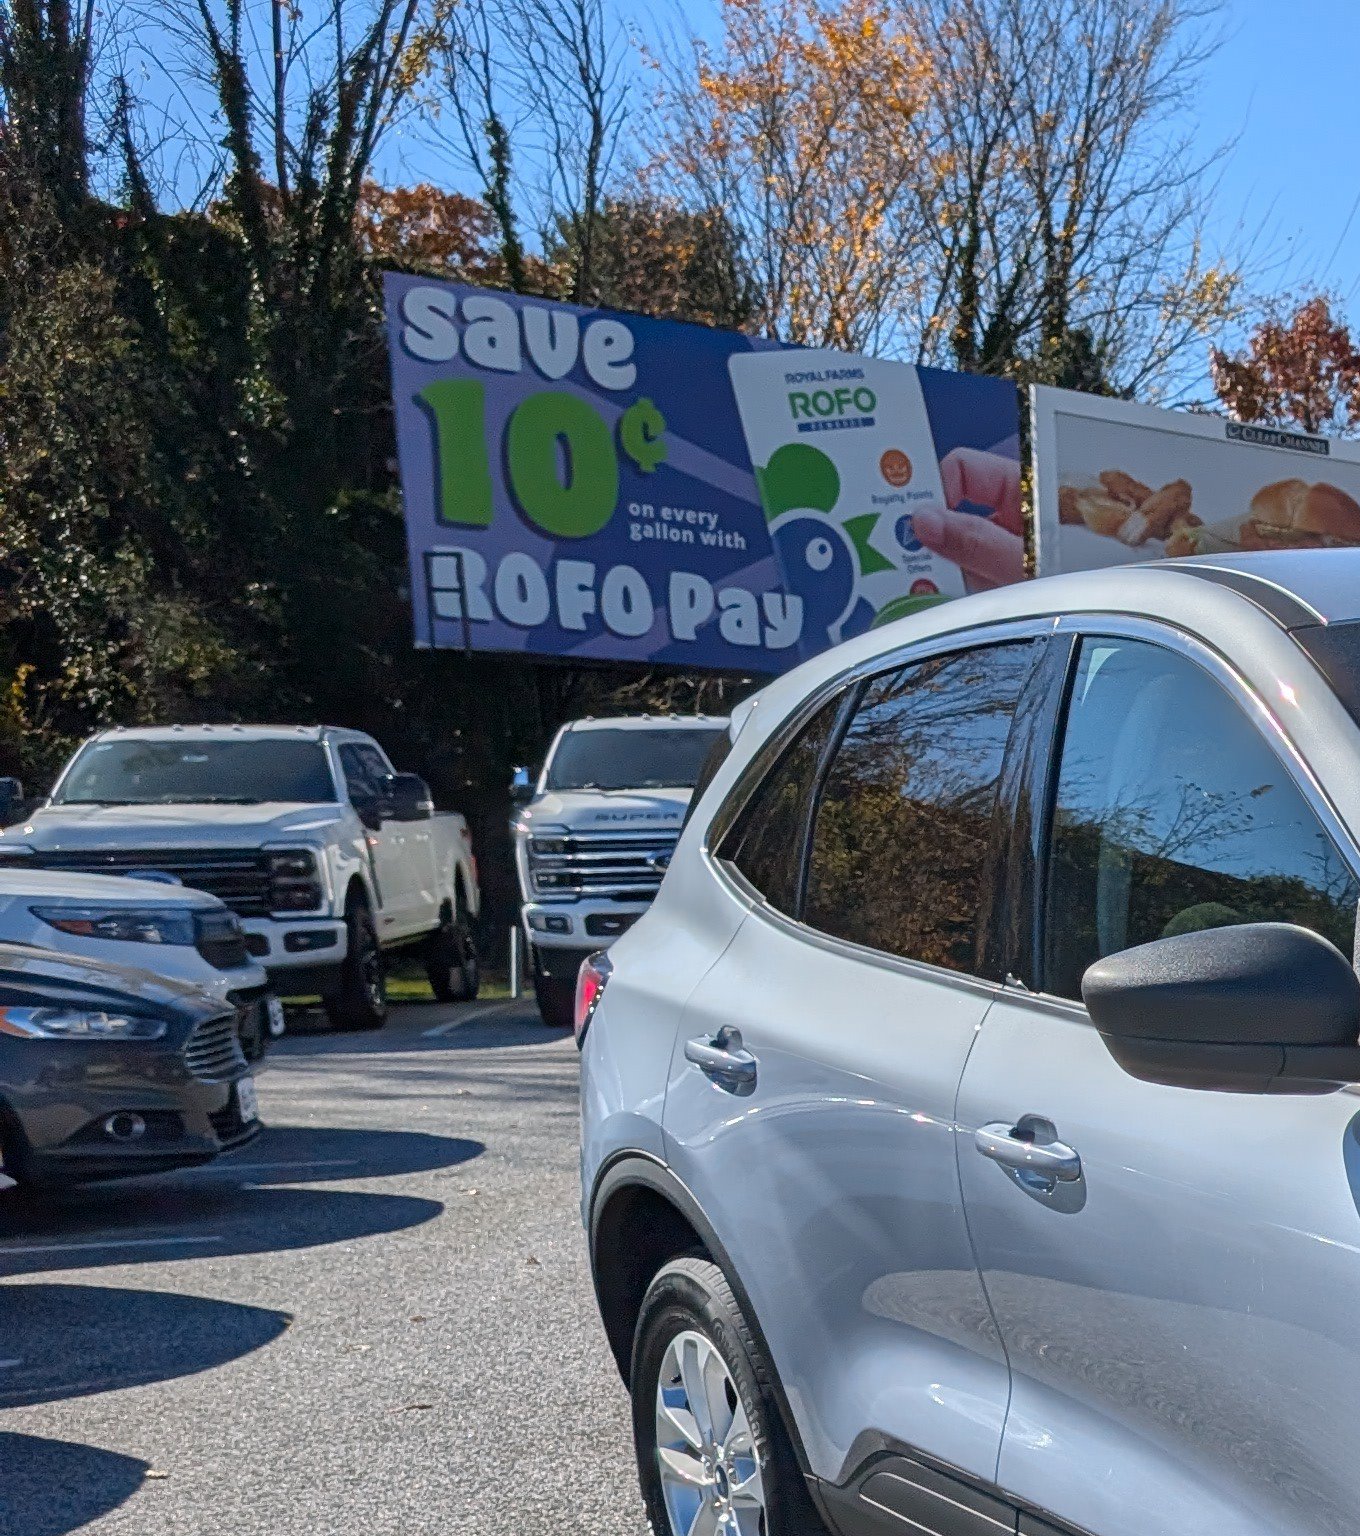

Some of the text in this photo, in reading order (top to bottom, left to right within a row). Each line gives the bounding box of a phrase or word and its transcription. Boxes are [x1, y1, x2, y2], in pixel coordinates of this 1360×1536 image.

[788, 386, 877, 419] ROFO
[628, 502, 719, 531] on every
[630, 522, 748, 551] gallon with
[669, 571, 803, 650] Pay
